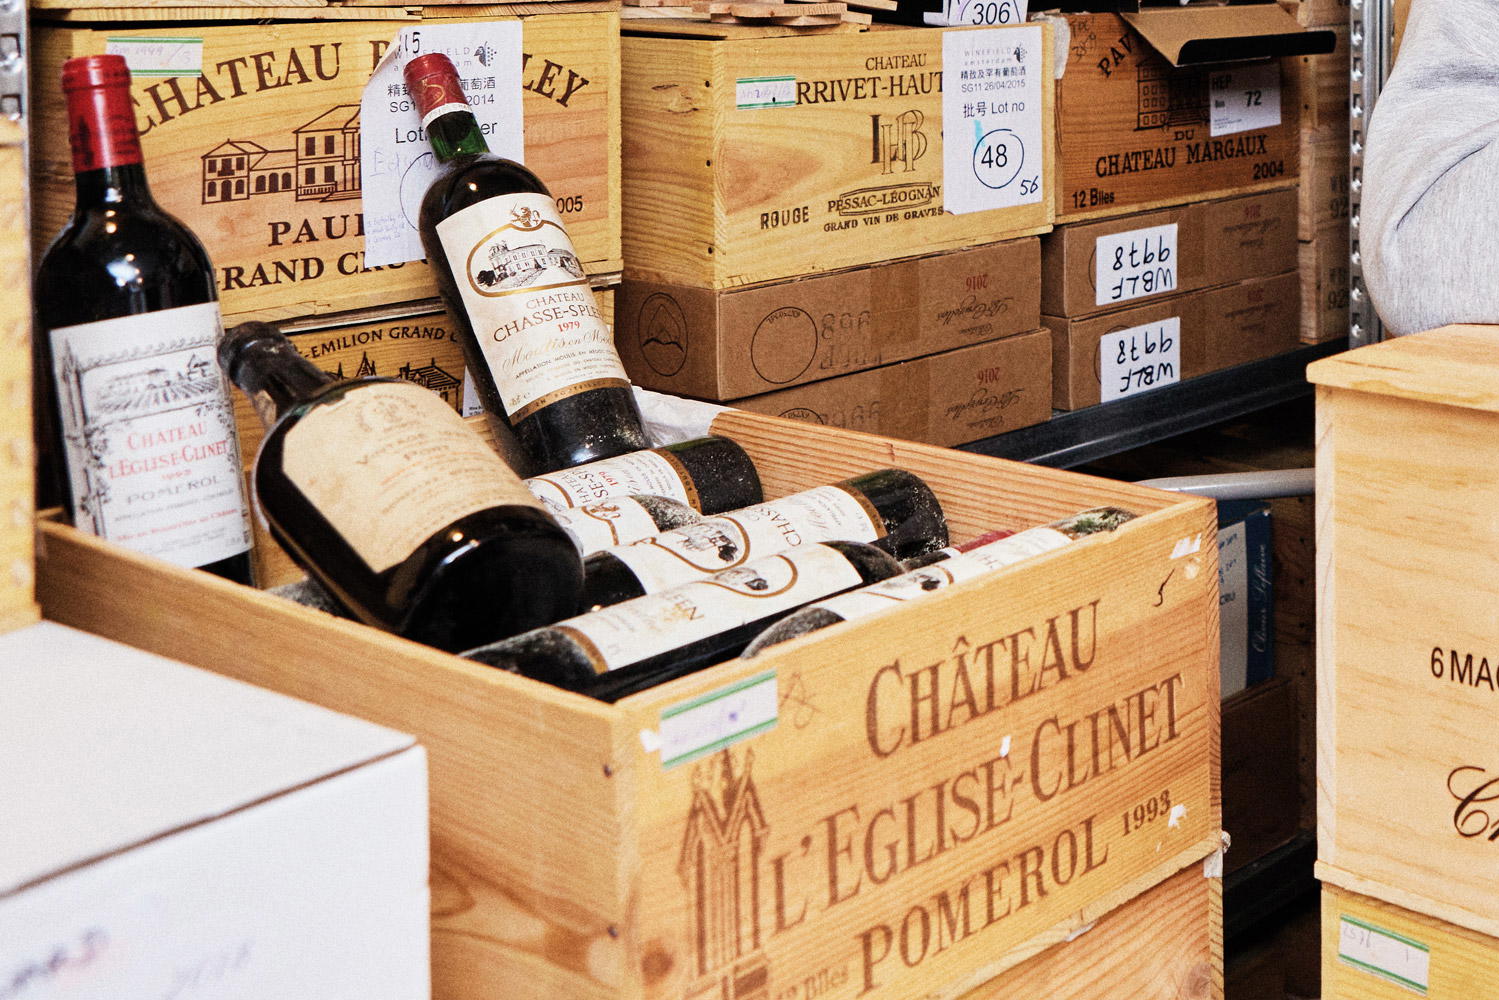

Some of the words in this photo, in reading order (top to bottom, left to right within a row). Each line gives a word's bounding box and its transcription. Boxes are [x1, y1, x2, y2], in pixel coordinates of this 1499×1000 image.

[972, 1, 1011, 26] 306
[865, 52, 928, 72] CHATEAU
[963, 102, 988, 119] 批号
[991, 102, 1010, 115] Lot
[1011, 101, 1026, 113] no
[1244, 89, 1263, 108] 72
[1174, 129, 1195, 142] DU
[981, 143, 1009, 169] 48
[1096, 146, 1177, 179] CHATEAU
[1186, 134, 1269, 165] MARGAUX
[1253, 160, 1285, 180] 2004
[1020, 175, 1041, 197] 56
[827, 185, 942, 215] PESSAC-LÉOGNAN
[1072, 190, 1087, 208] 12
[760, 206, 810, 231] ROUGE
[823, 216, 860, 233] GRAND
[862, 214, 881, 227] VIN
[885, 212, 900, 224] DE
[903, 205, 945, 222] GRAVES
[965, 273, 989, 291] 2016
[1111, 265, 1173, 300] WBLF
[525, 292, 585, 310] CHATEAU
[388, 326, 446, 341] GRAND
[556, 320, 581, 333] 1979
[977, 367, 1001, 386] 2016
[1119, 361, 1174, 393] WBLF
[127, 421, 209, 451] CHATEAU
[1429, 646, 1446, 680] 6
[865, 599, 1102, 760] CHÂTEAU
[768, 671, 1187, 939] L'EGLISE-CLINET
[855, 812, 1109, 998] POMEROL
[1121, 788, 1172, 837] 1993
